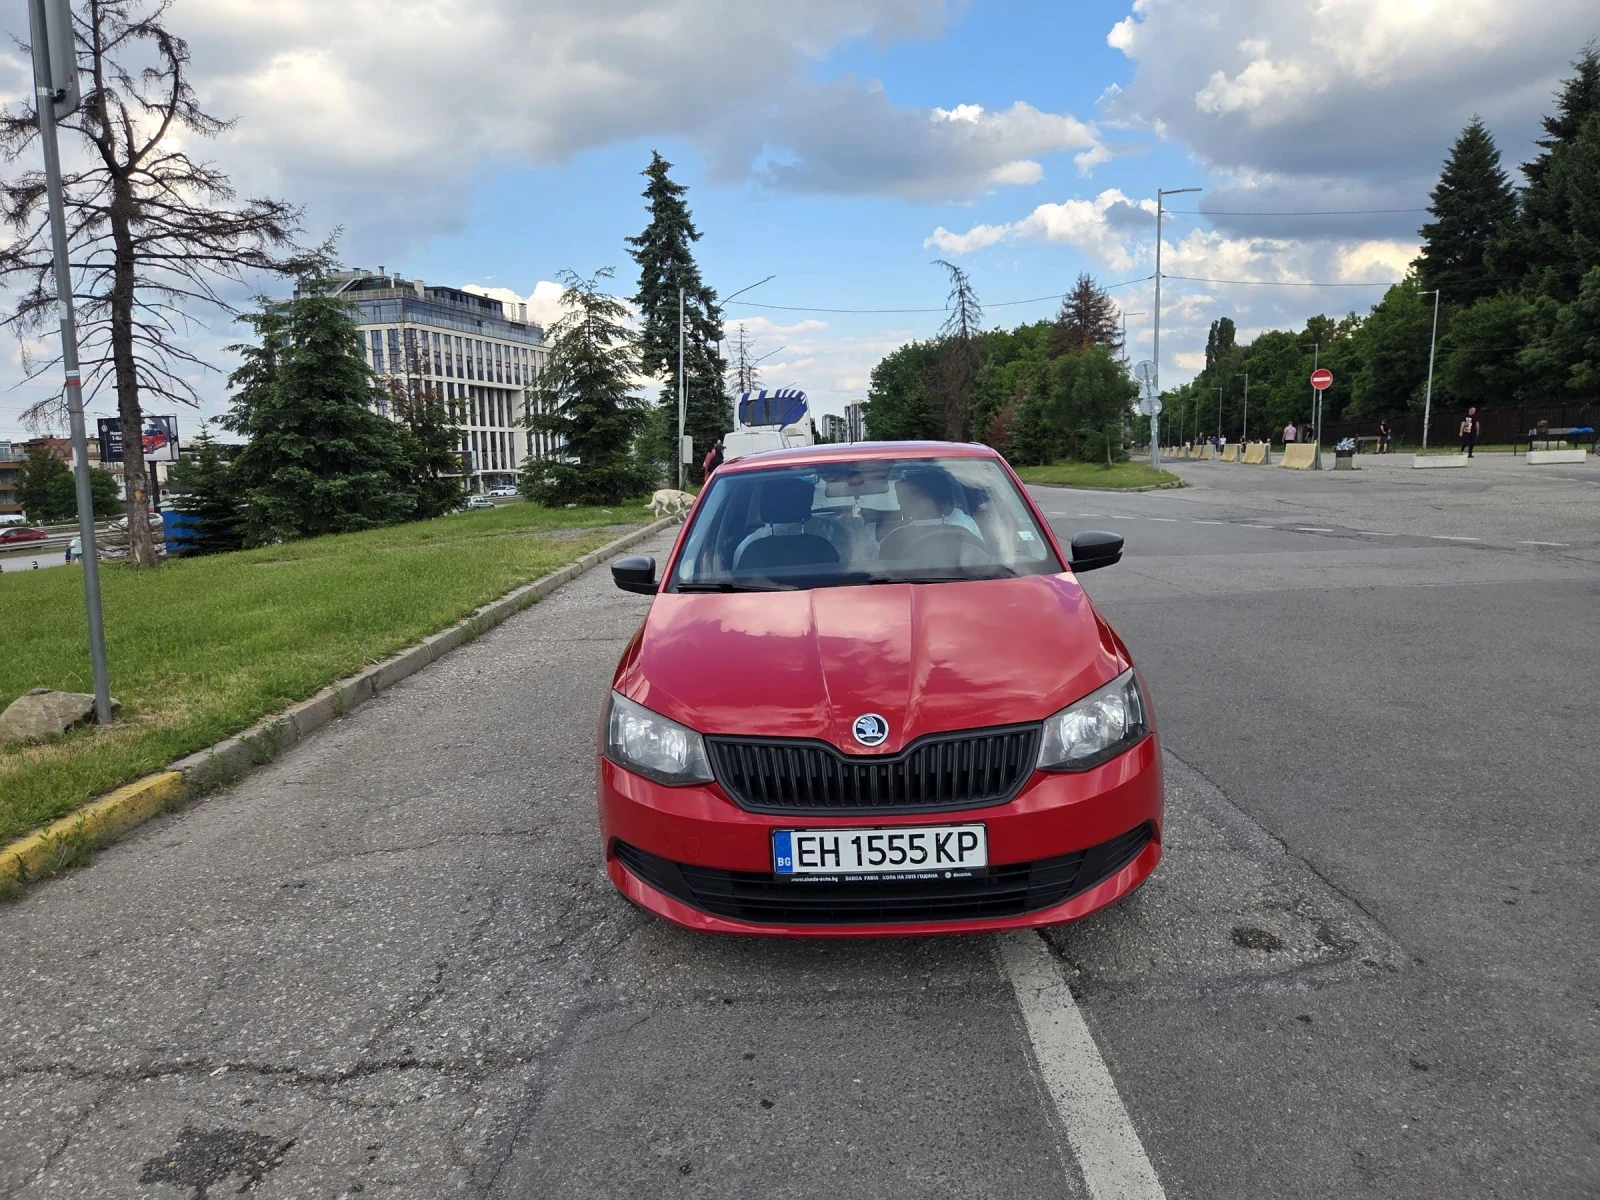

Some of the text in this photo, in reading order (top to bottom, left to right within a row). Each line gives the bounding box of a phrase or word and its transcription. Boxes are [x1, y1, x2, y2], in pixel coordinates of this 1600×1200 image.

[797, 831, 978, 867] EH 1555 KP
[777, 857, 791, 867] BG
